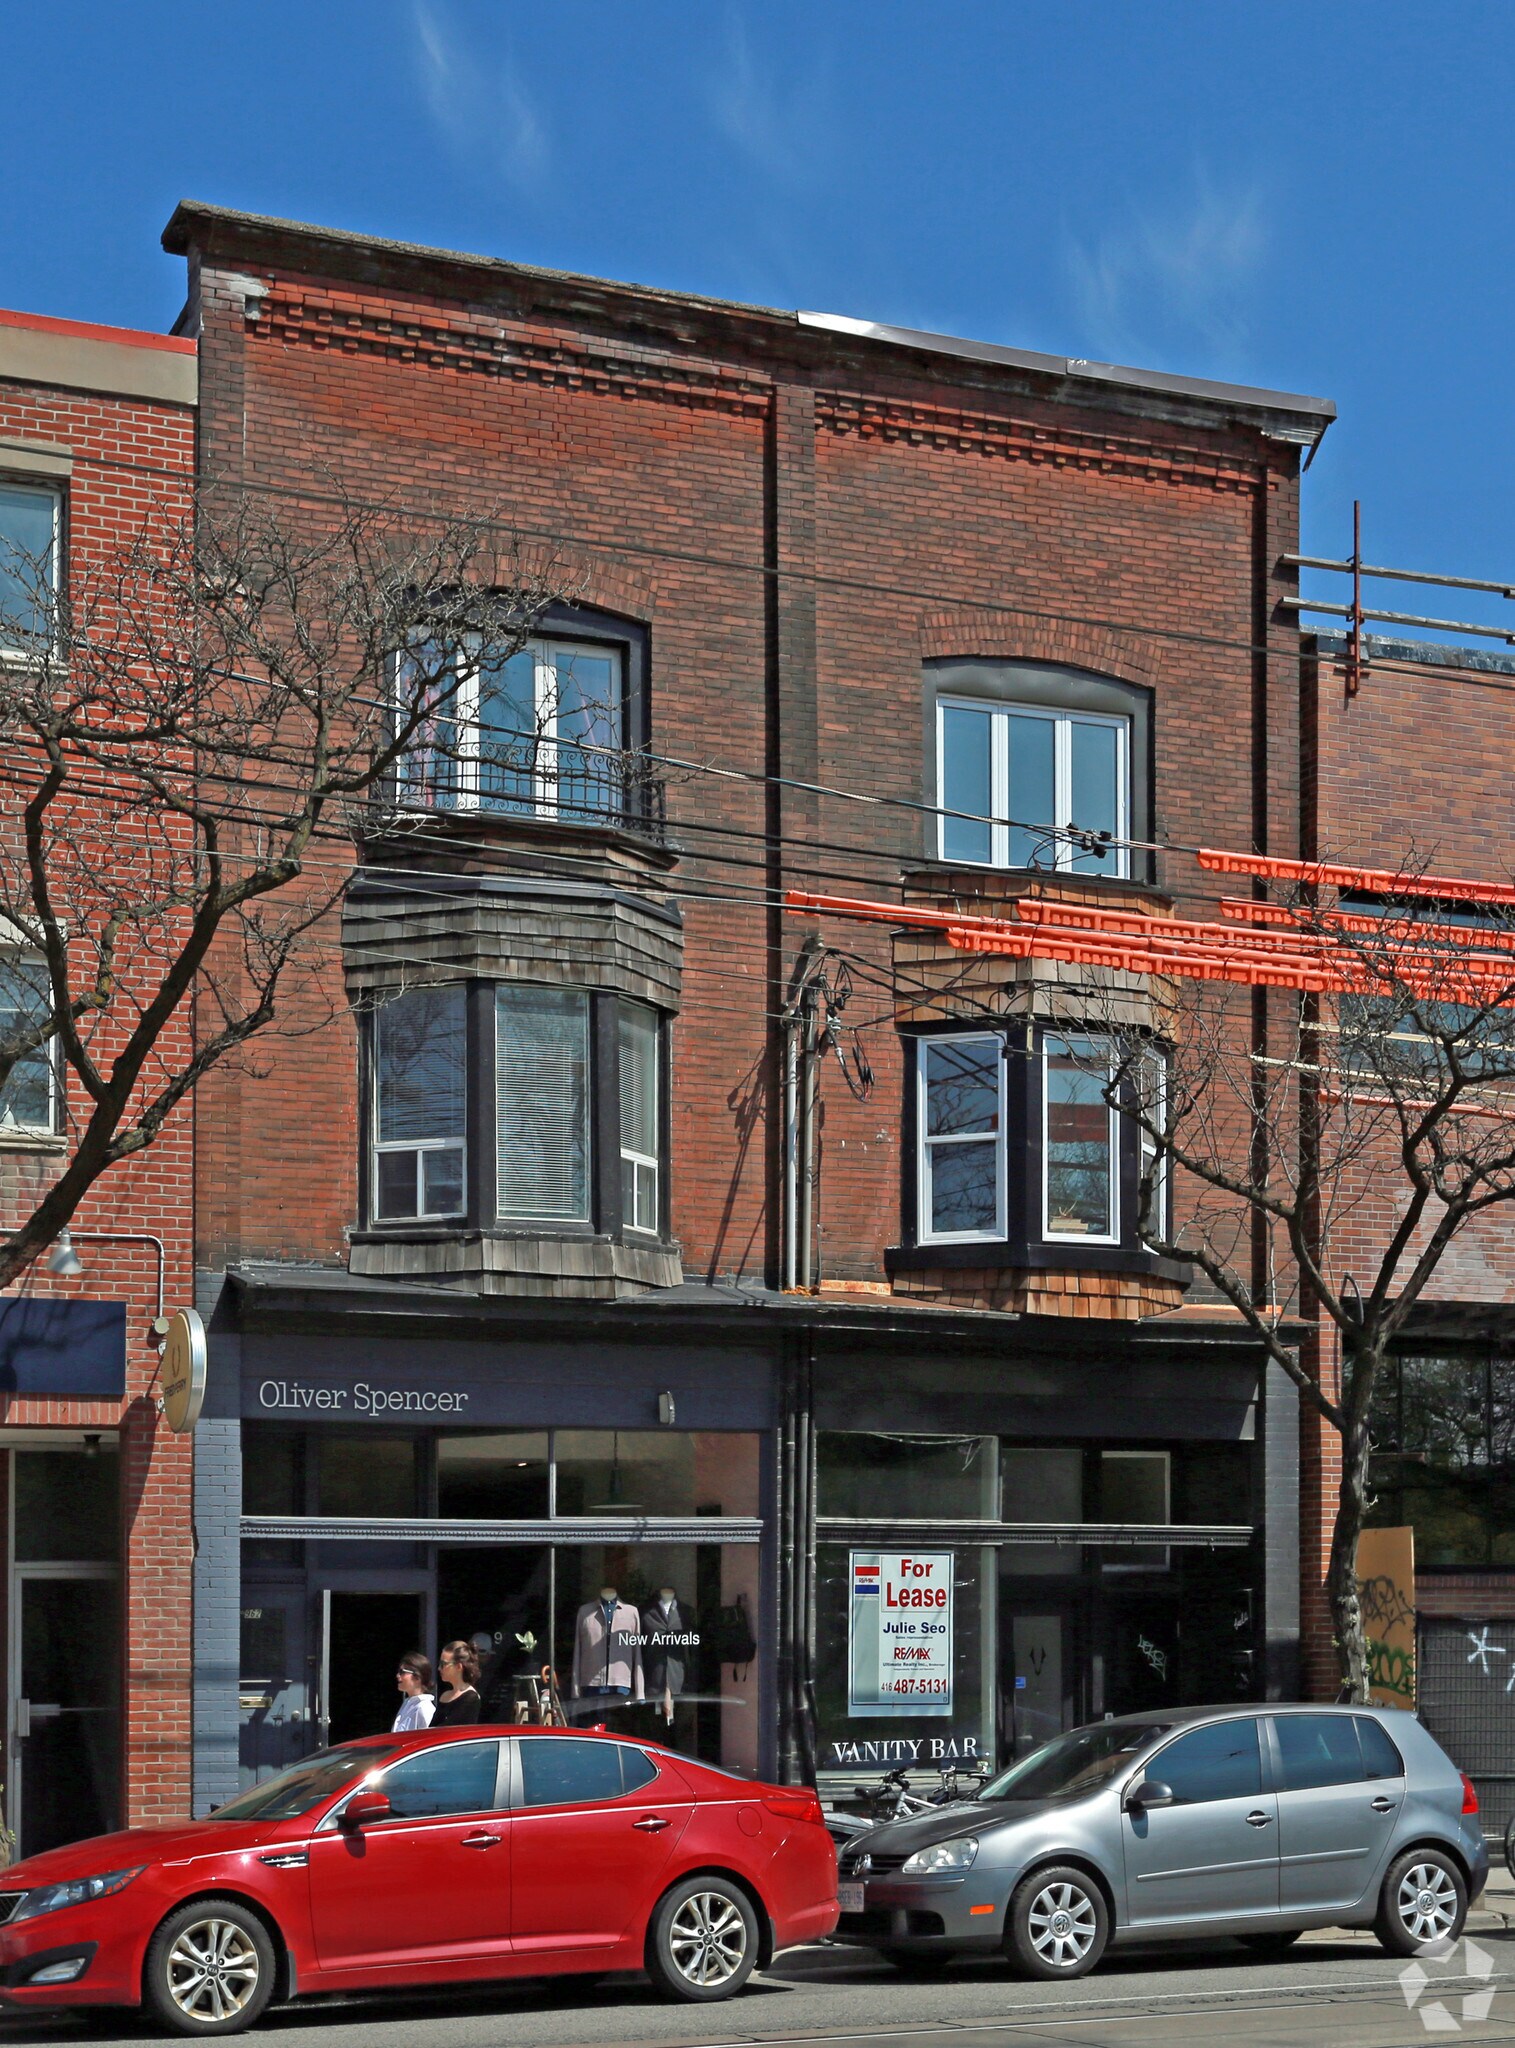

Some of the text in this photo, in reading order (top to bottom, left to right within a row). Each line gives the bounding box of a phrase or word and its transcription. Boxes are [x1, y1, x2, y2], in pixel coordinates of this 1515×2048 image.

[259, 1381, 469, 1416] Oliver Spencer
[901, 1559, 934, 1577] For
[886, 1582, 947, 1608] Lease
[882, 1621, 946, 1634] Julie Seo
[618, 1631, 700, 1646] New Arrivals
[893, 1646, 932, 1660] RE/MAX
[881, 1678, 947, 1694] 416 487-5131
[832, 1737, 978, 1763] VANITY BAR
